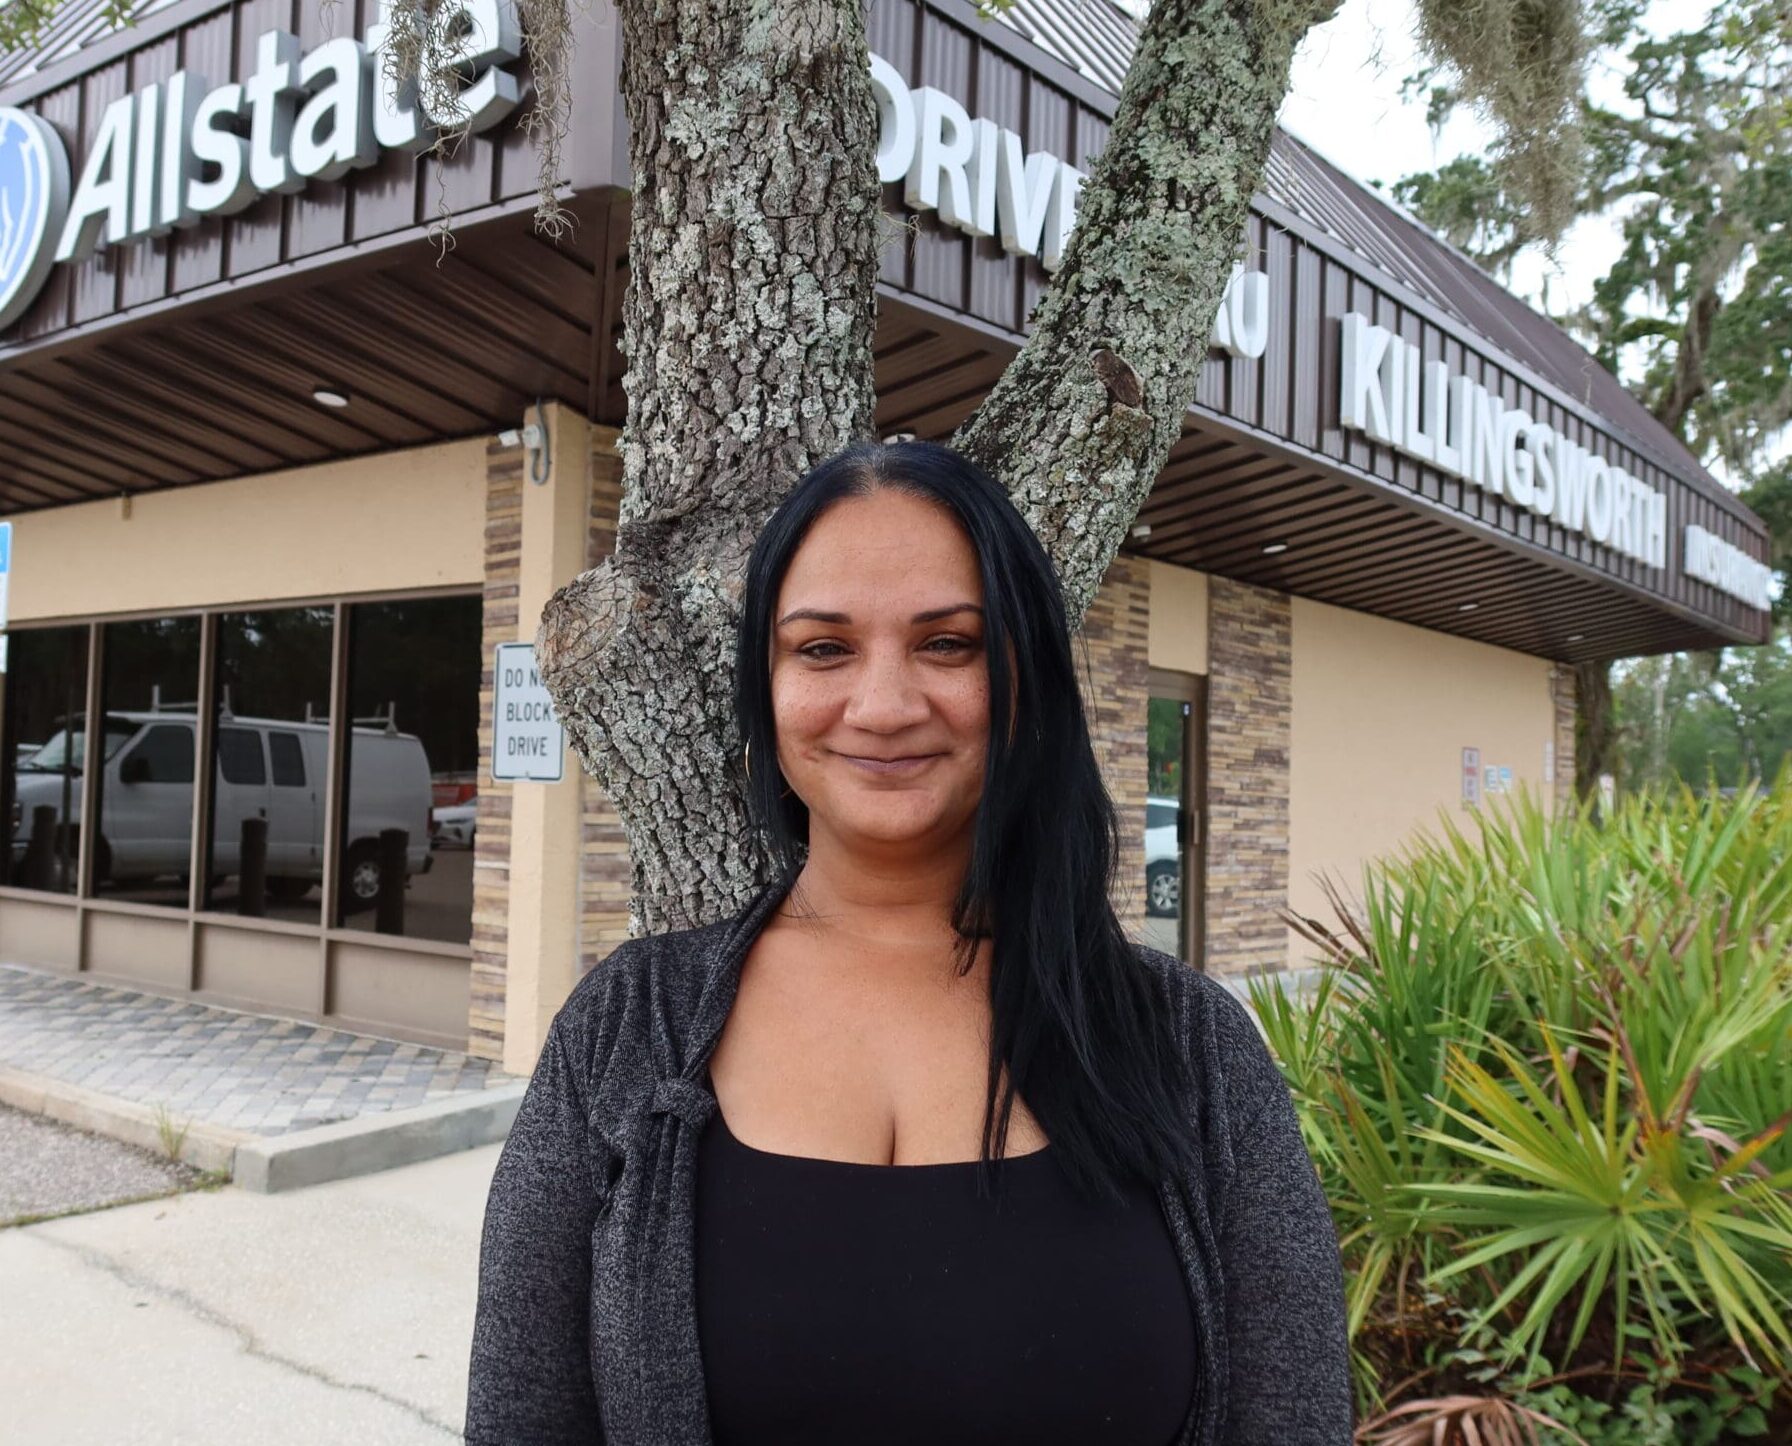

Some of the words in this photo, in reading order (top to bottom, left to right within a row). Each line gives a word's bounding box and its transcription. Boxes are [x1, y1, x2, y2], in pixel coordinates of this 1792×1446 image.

[54, 0, 504, 263] Allstate
[1343, 312, 1667, 569] KILLINGSWORTH
[505, 668, 523, 688] DO
[506, 702, 551, 722] BLOCK
[508, 735, 548, 756] DRIVE
